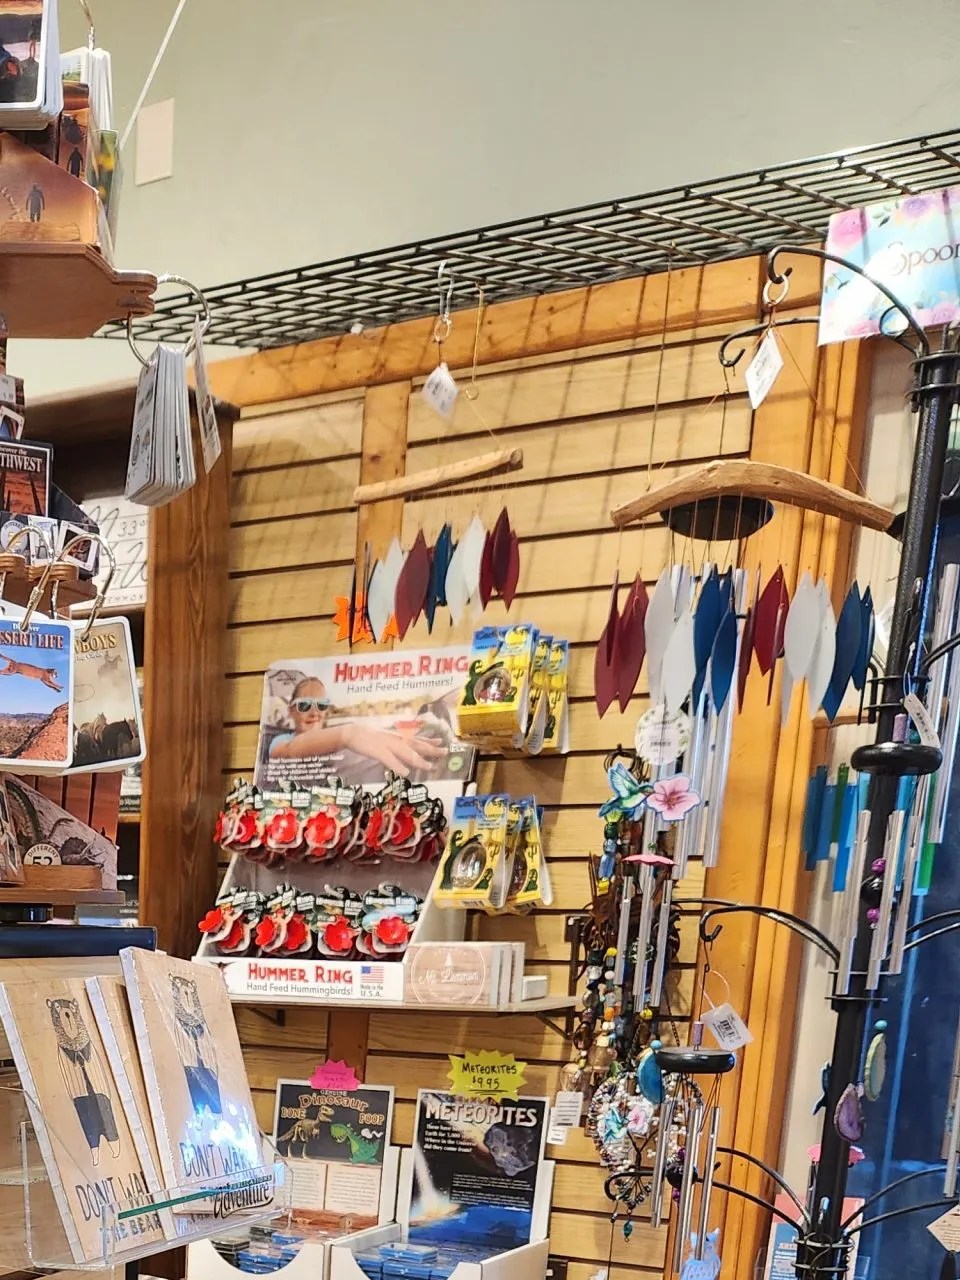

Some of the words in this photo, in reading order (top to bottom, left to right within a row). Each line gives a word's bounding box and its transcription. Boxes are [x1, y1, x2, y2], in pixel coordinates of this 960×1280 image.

[17, 448, 28, 456] the
[37, 633, 64, 650] LIFE
[334, 661, 413, 684] HUMMER
[417, 654, 470, 677] RING
[346, 681, 373, 694] Hand
[375, 679, 400, 692] Feed
[401, 676, 454, 690] Hummers!
[27, 845, 59, 859] DIFFERENT
[247, 962, 309, 983] HUMMER
[314, 965, 354, 985] RING
[246, 982, 268, 992] Hand
[269, 983, 289, 993] Feed
[290, 984, 354, 998] Hummingbirds!
[461, 1062, 517, 1075] METEORITES
[299, 1093, 369, 1112] Dinosaur
[281, 1106, 307, 1119] BONE
[359, 1112, 385, 1126] POOP
[425, 1101, 538, 1128] METEORITES
[179, 1141, 215, 1178] DON'T
[75, 1176, 120, 1221] DON'T
[130, 1213, 163, 1237] BEAR
